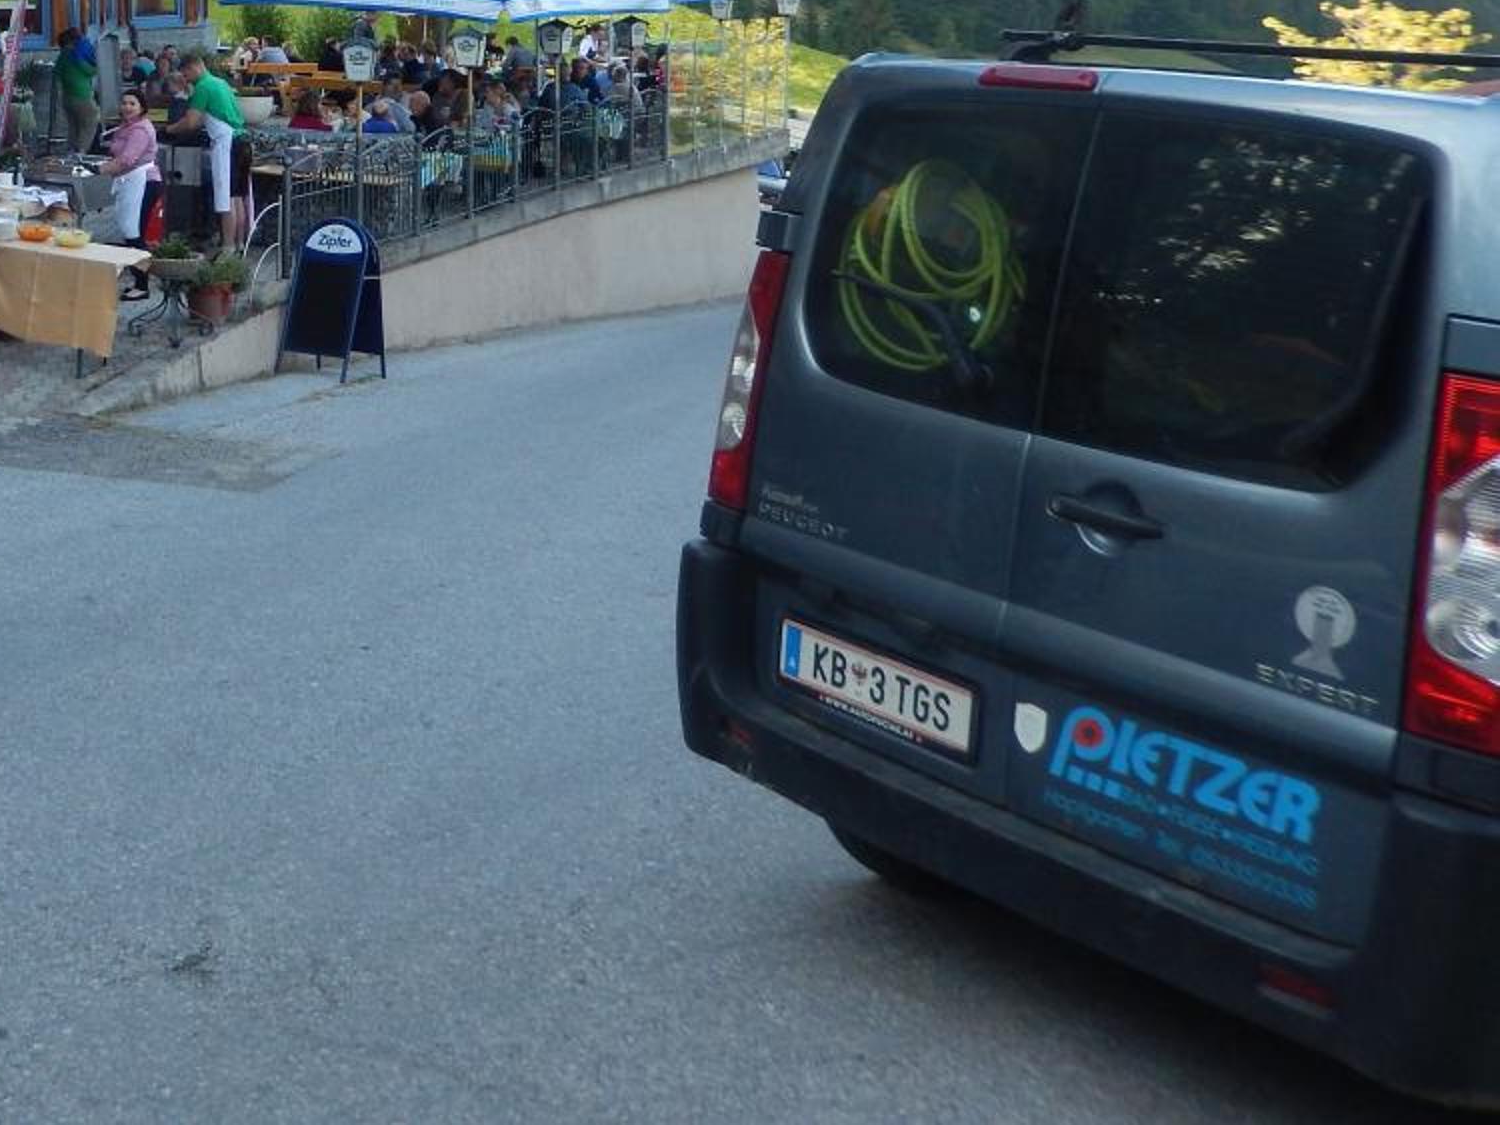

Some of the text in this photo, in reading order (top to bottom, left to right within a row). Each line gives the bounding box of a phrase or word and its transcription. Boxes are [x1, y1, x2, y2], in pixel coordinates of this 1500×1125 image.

[317, 233, 353, 251] Zipfer
[812, 641, 848, 689] KB
[868, 665, 886, 706] 3
[894, 674, 951, 733] TGS
[1255, 661, 1381, 715] EXPERT
